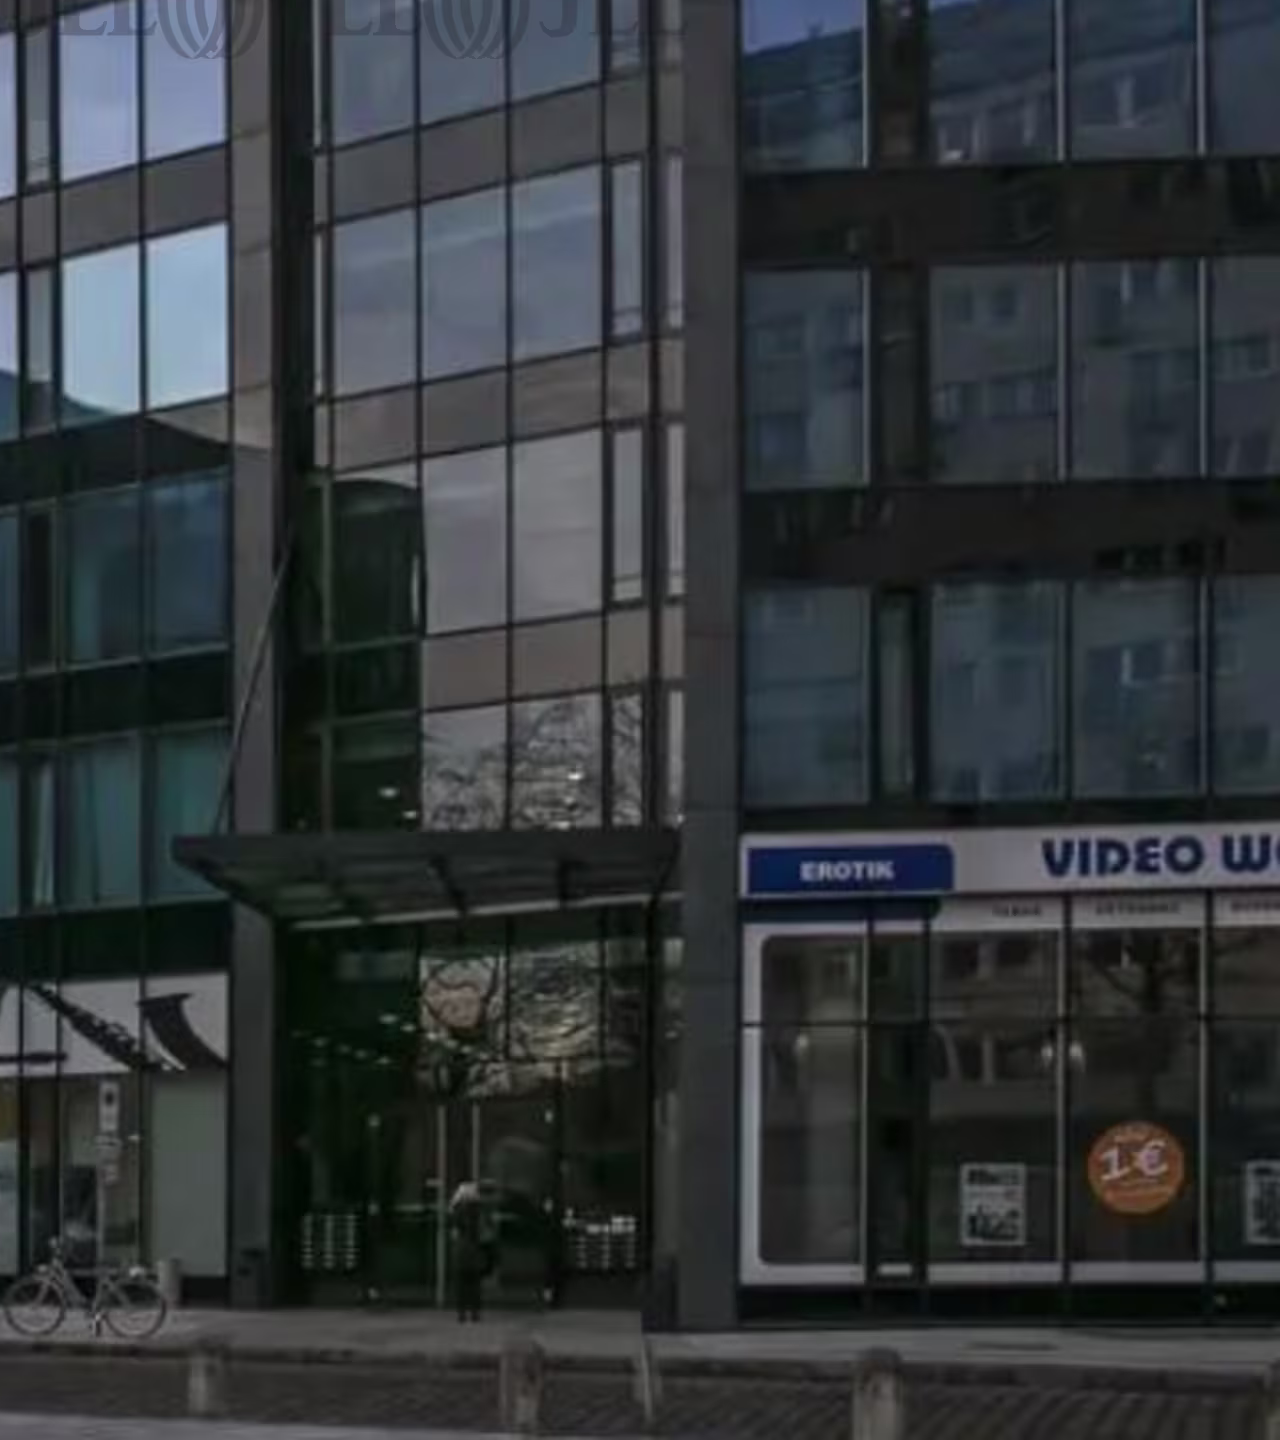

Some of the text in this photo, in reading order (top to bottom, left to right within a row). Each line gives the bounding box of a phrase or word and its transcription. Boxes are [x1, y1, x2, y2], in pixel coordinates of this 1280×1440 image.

[799, 861, 895, 883] EROTIK
[1042, 833, 1280, 879] VIDEO W
